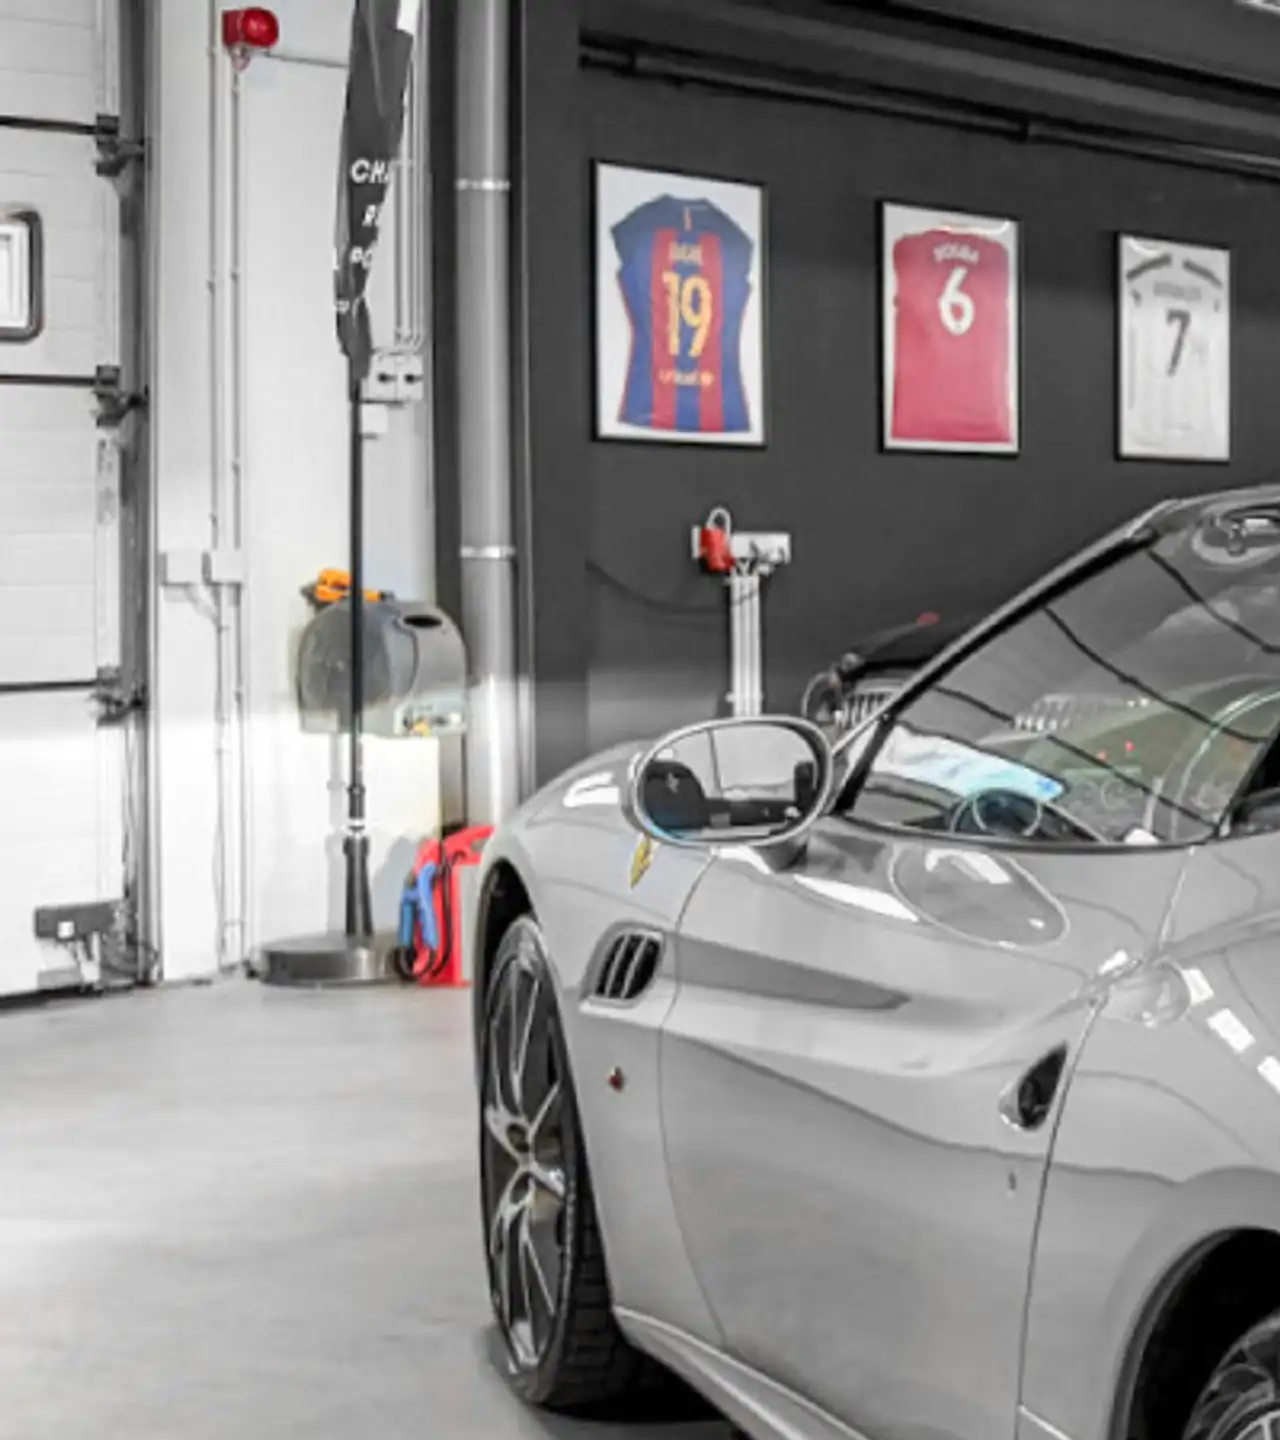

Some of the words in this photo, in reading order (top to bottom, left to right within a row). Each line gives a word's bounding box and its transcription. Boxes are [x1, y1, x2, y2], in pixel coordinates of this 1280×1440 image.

[662, 269, 712, 358] 19
[938, 266, 974, 335] 6
[1166, 308, 1192, 377] 7
